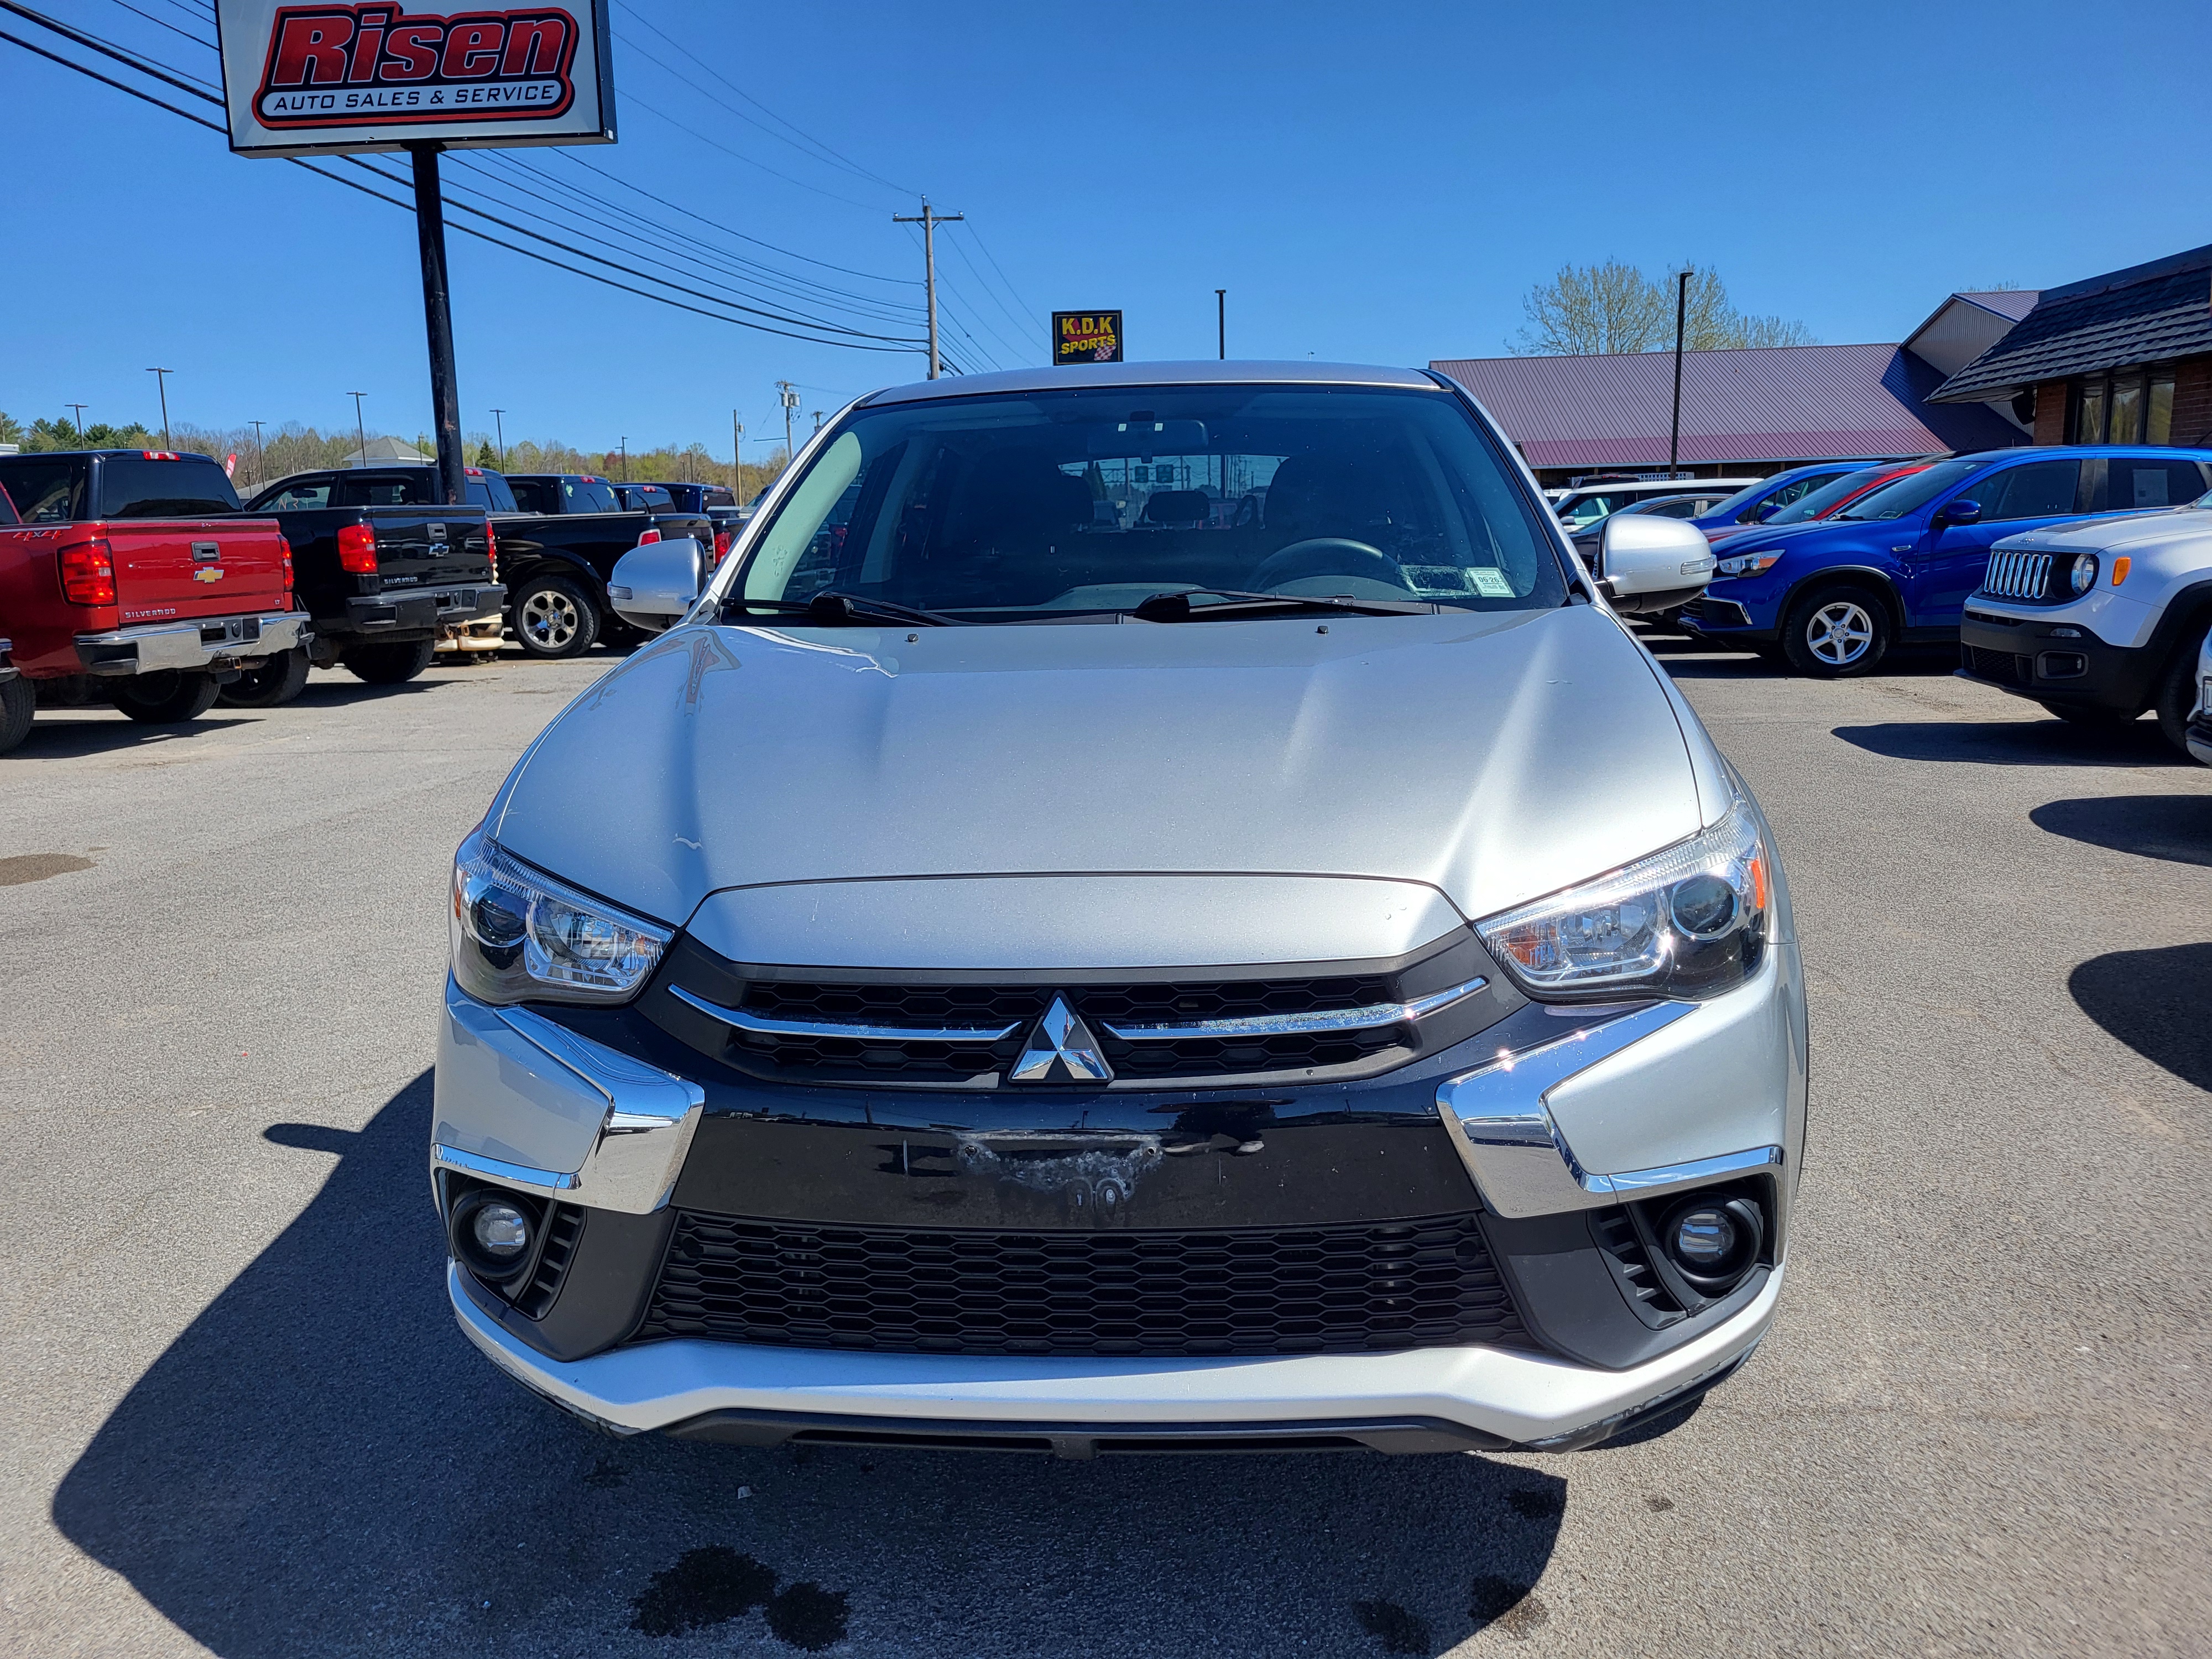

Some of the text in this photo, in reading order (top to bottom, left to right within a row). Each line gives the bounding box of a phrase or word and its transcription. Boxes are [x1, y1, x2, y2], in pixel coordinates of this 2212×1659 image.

[271, 13, 566, 86] Risen
[274, 85, 555, 111] AUTO SALES & SERVICE
[1062, 316, 1114, 335] K.D.K
[1061, 334, 1116, 354] SPORTS
[125, 608, 176, 618] SILVERADO
